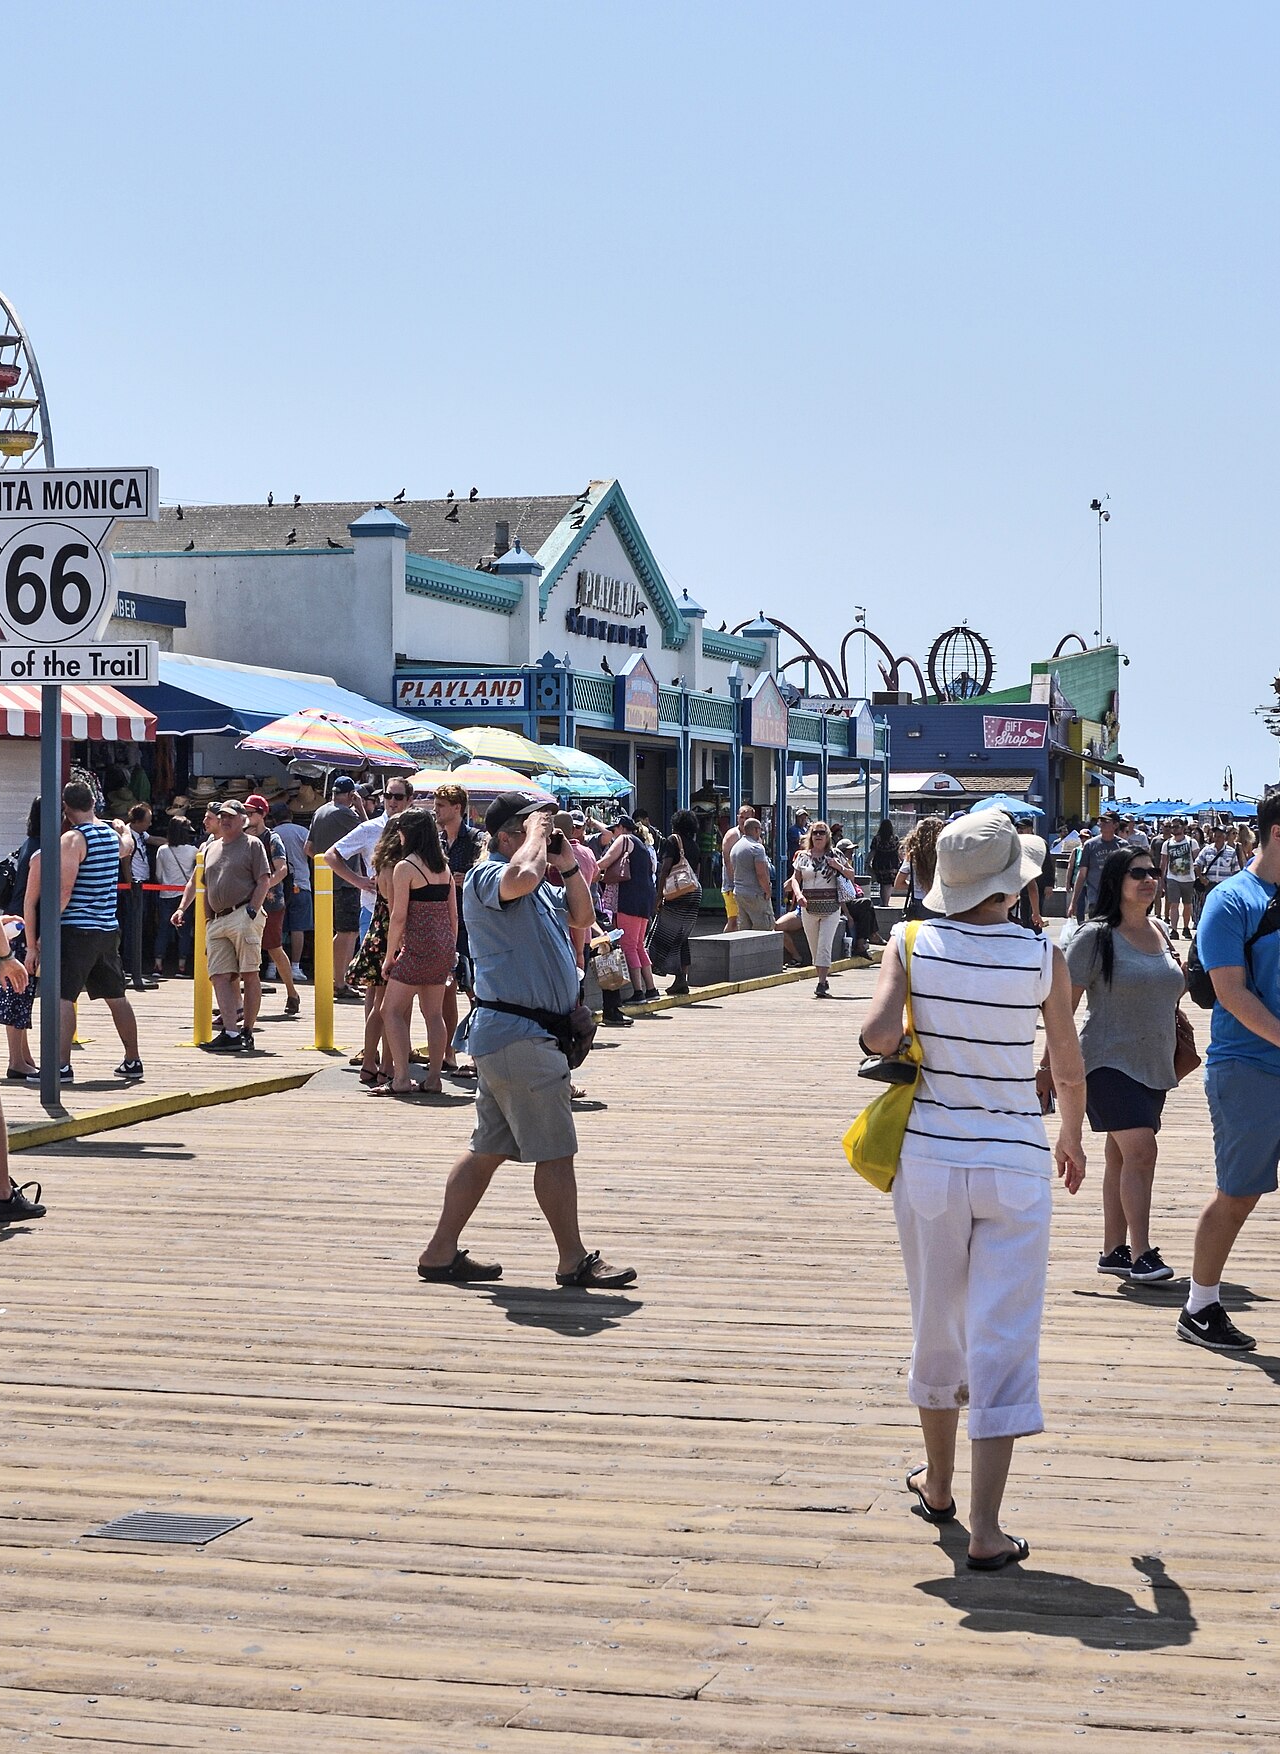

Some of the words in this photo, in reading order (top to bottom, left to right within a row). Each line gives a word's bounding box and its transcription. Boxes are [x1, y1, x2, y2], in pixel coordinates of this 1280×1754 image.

[42, 478, 143, 510] MONICA
[5, 542, 92, 626] 66
[10, 650, 35, 677] of
[43, 649, 81, 677] the
[89, 648, 140, 676] Trail
[398, 680, 522, 698] PLAYLAND
[417, 698, 504, 706] ARCADE
[753, 718, 786, 743] PRIZES
[1005, 721, 1023, 732] GIFT
[995, 730, 1030, 747] Shop
